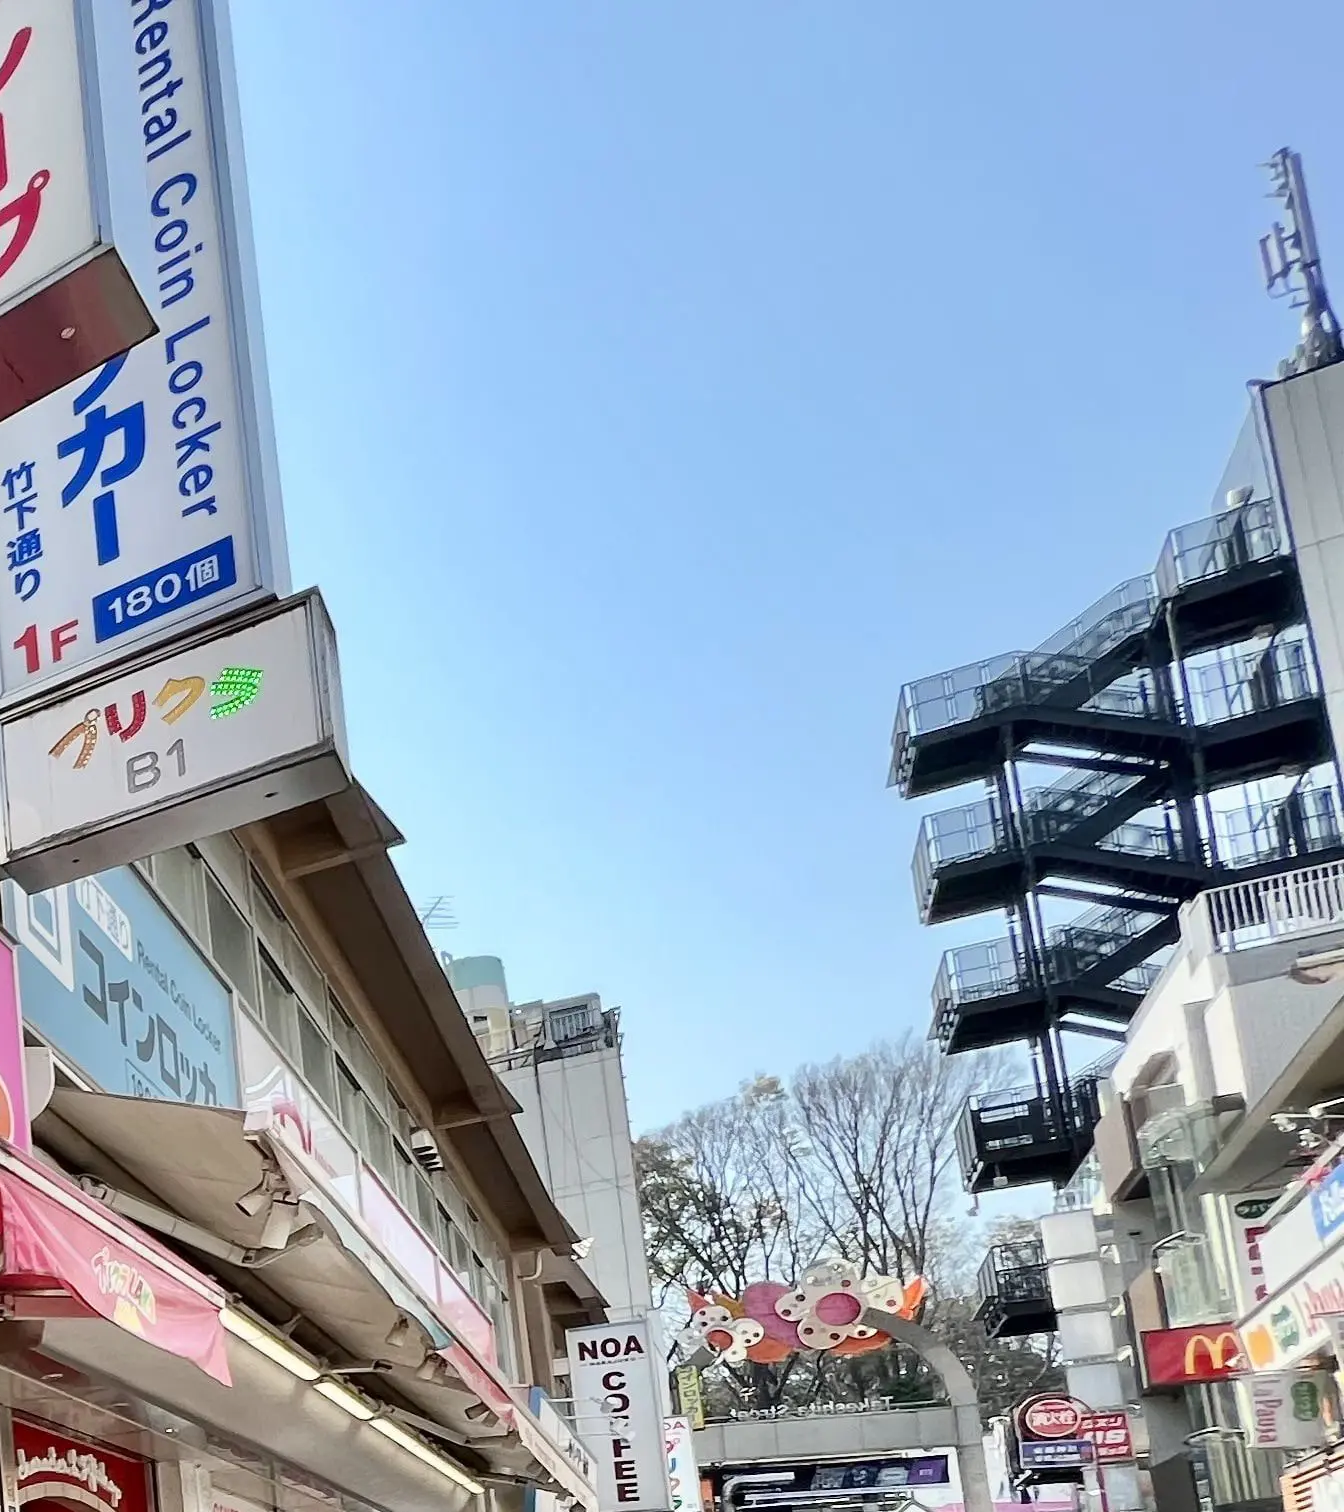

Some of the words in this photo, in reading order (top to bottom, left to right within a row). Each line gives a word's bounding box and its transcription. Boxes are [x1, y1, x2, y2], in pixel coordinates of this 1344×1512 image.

[151, 172, 202, 309] Coin
[165, 316, 222, 518] Locker
[2, 461, 43, 602] 竹下通り
[108, 554, 220, 625] 180個
[13, 620, 79, 675] 1F
[48, 667, 264, 769] プリクラ
[125, 739, 188, 794] B1
[577, 1334, 645, 1361] NOA
